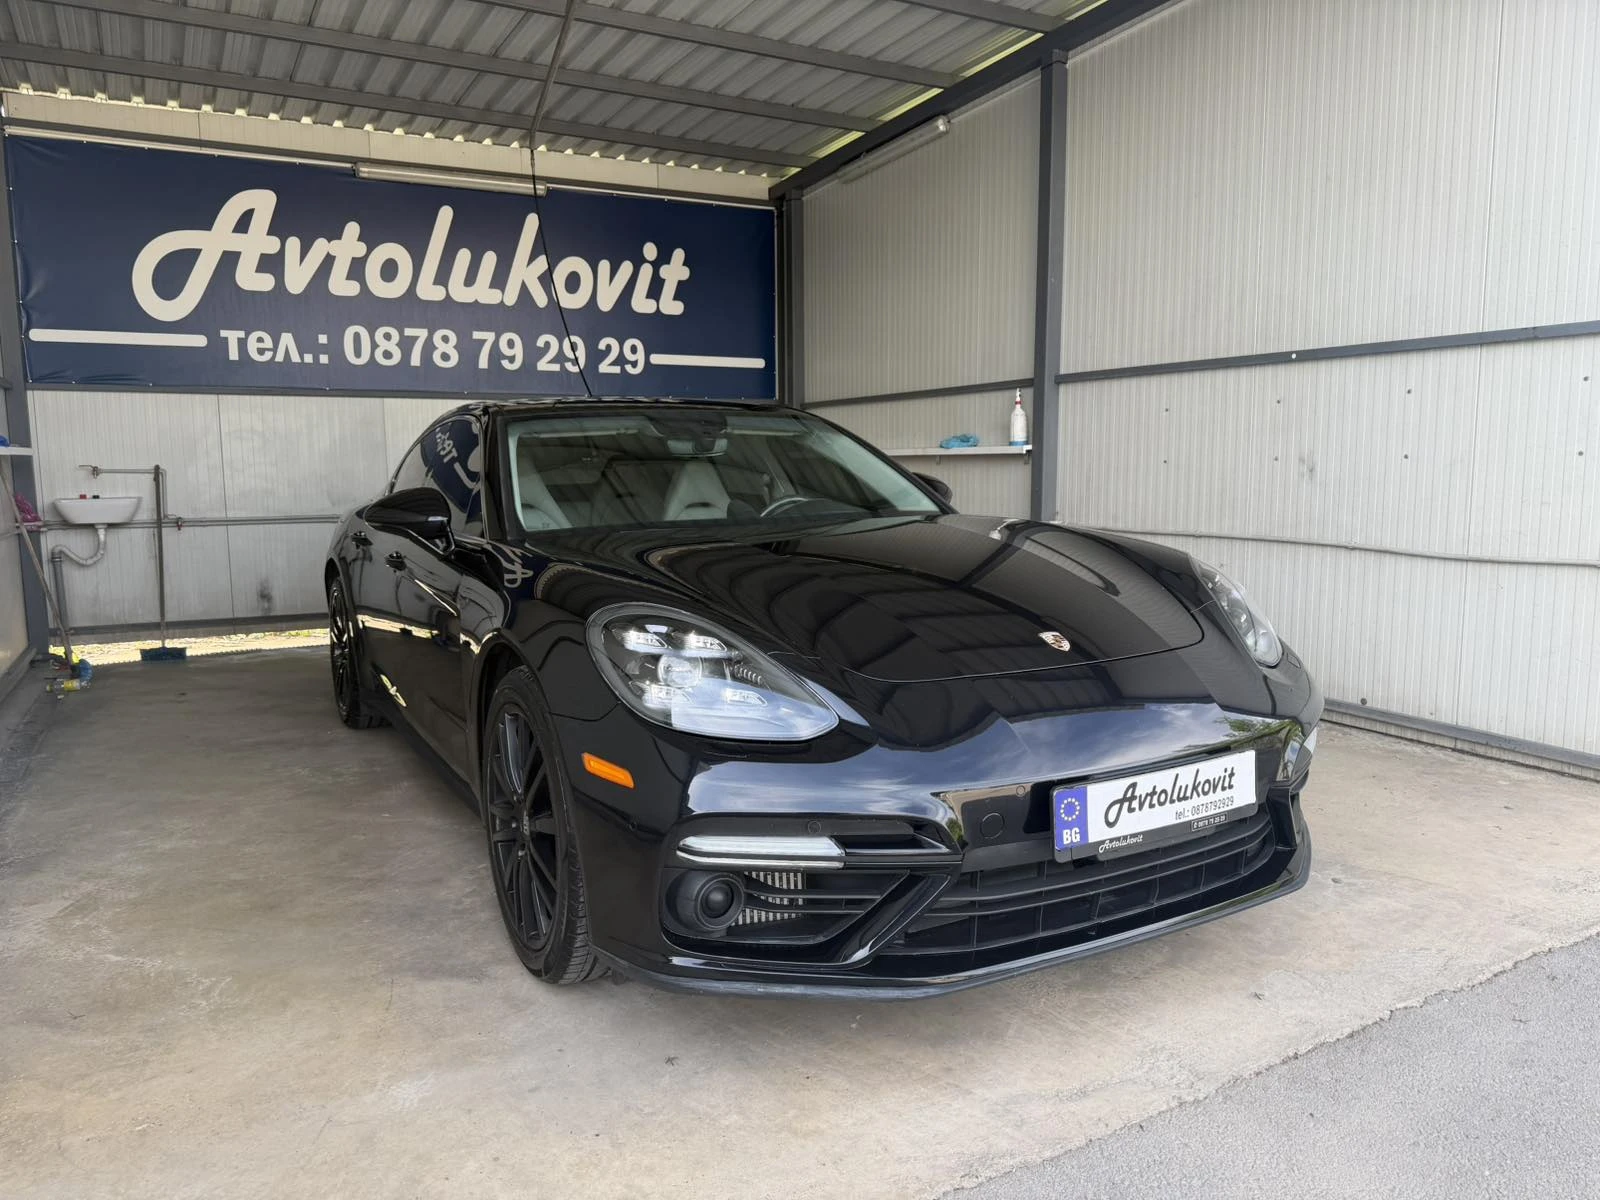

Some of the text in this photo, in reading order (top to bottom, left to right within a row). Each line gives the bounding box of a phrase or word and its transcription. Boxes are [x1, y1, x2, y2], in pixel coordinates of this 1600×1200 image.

[131, 188, 691, 322] Avtolukovit
[219, 325, 645, 375] тел.: 0878 79 29 29
[1104, 766, 1236, 829] Avtolukovit
[1062, 827, 1081, 845] BG
[1098, 834, 1144, 854] Avtolukovit
